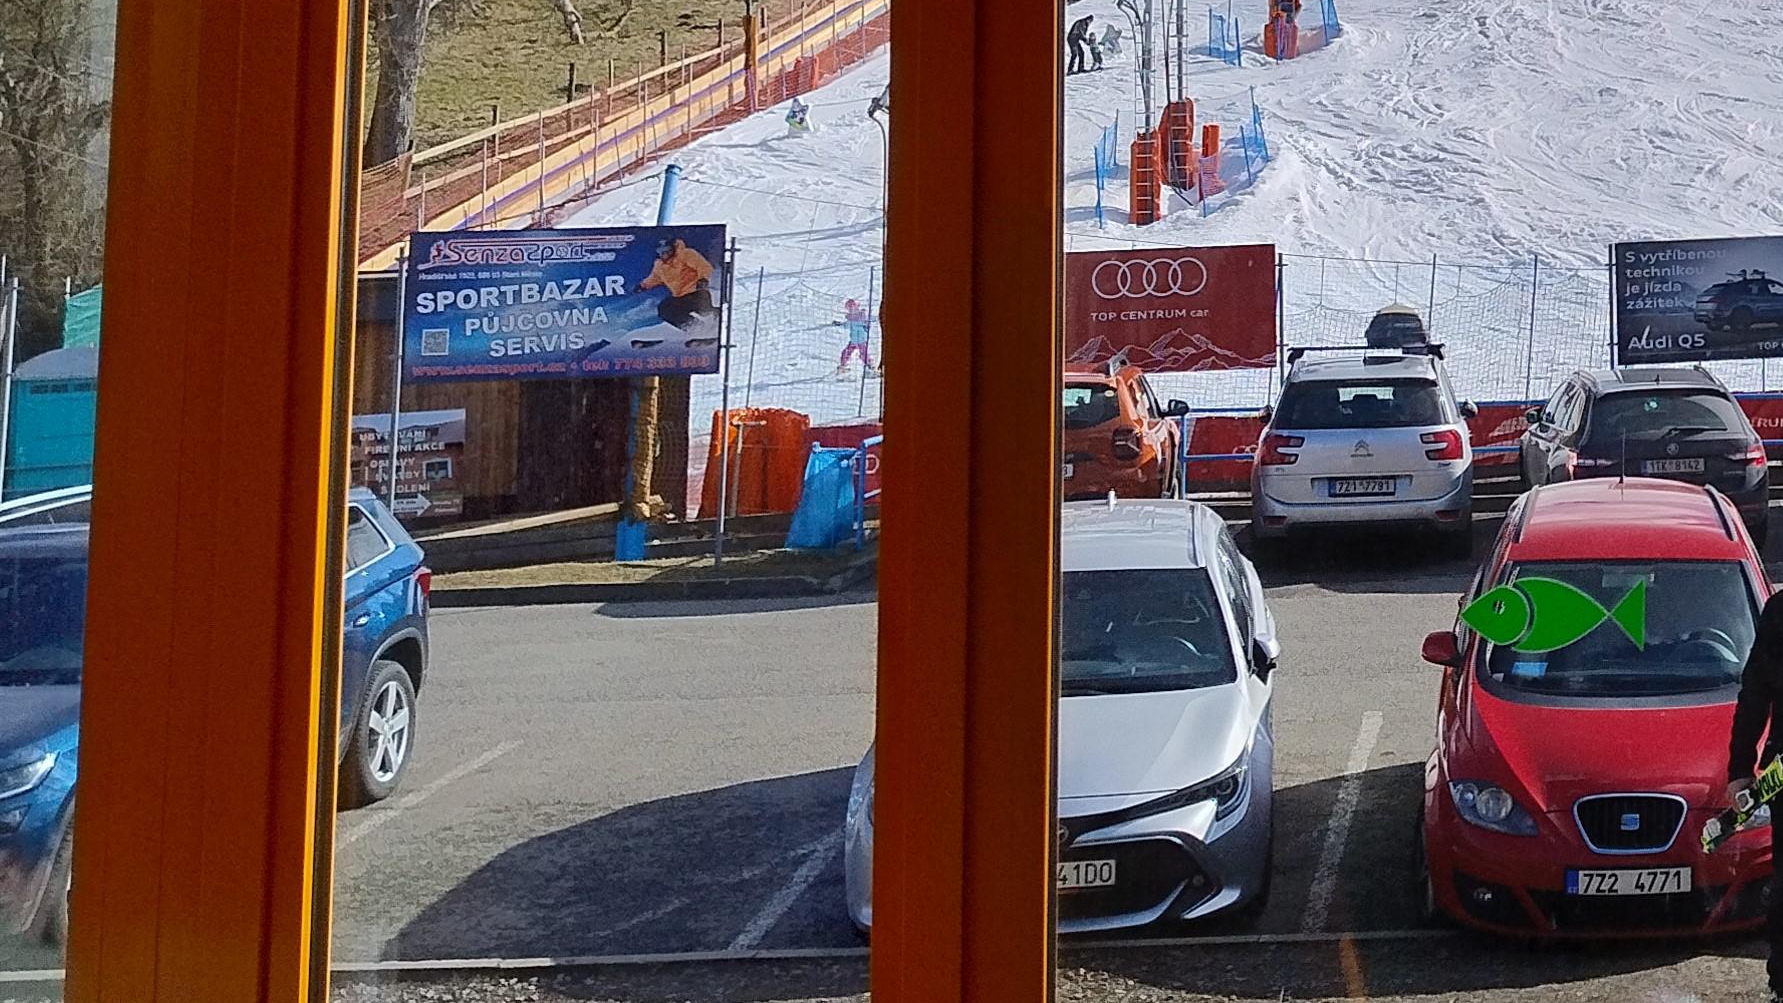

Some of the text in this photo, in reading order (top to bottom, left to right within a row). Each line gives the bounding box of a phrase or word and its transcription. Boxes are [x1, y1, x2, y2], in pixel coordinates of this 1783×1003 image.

[1625, 248, 1726, 265] S vytříbenou
[1625, 265, 1704, 278] technikou
[416, 275, 625, 314] SPORTBAZAR
[1624, 281, 1682, 297] je jízda
[1626, 297, 1688, 310] zážitek
[1090, 309, 1209, 322] TOP CENTRUM car
[489, 332, 585, 358] SERVIS
[1628, 332, 1706, 350] Audi Q5
[1758, 340, 1778, 351] TOP
[415, 442, 446, 452] AKCE
[1583, 870, 1681, 894] 7Z2 4771
